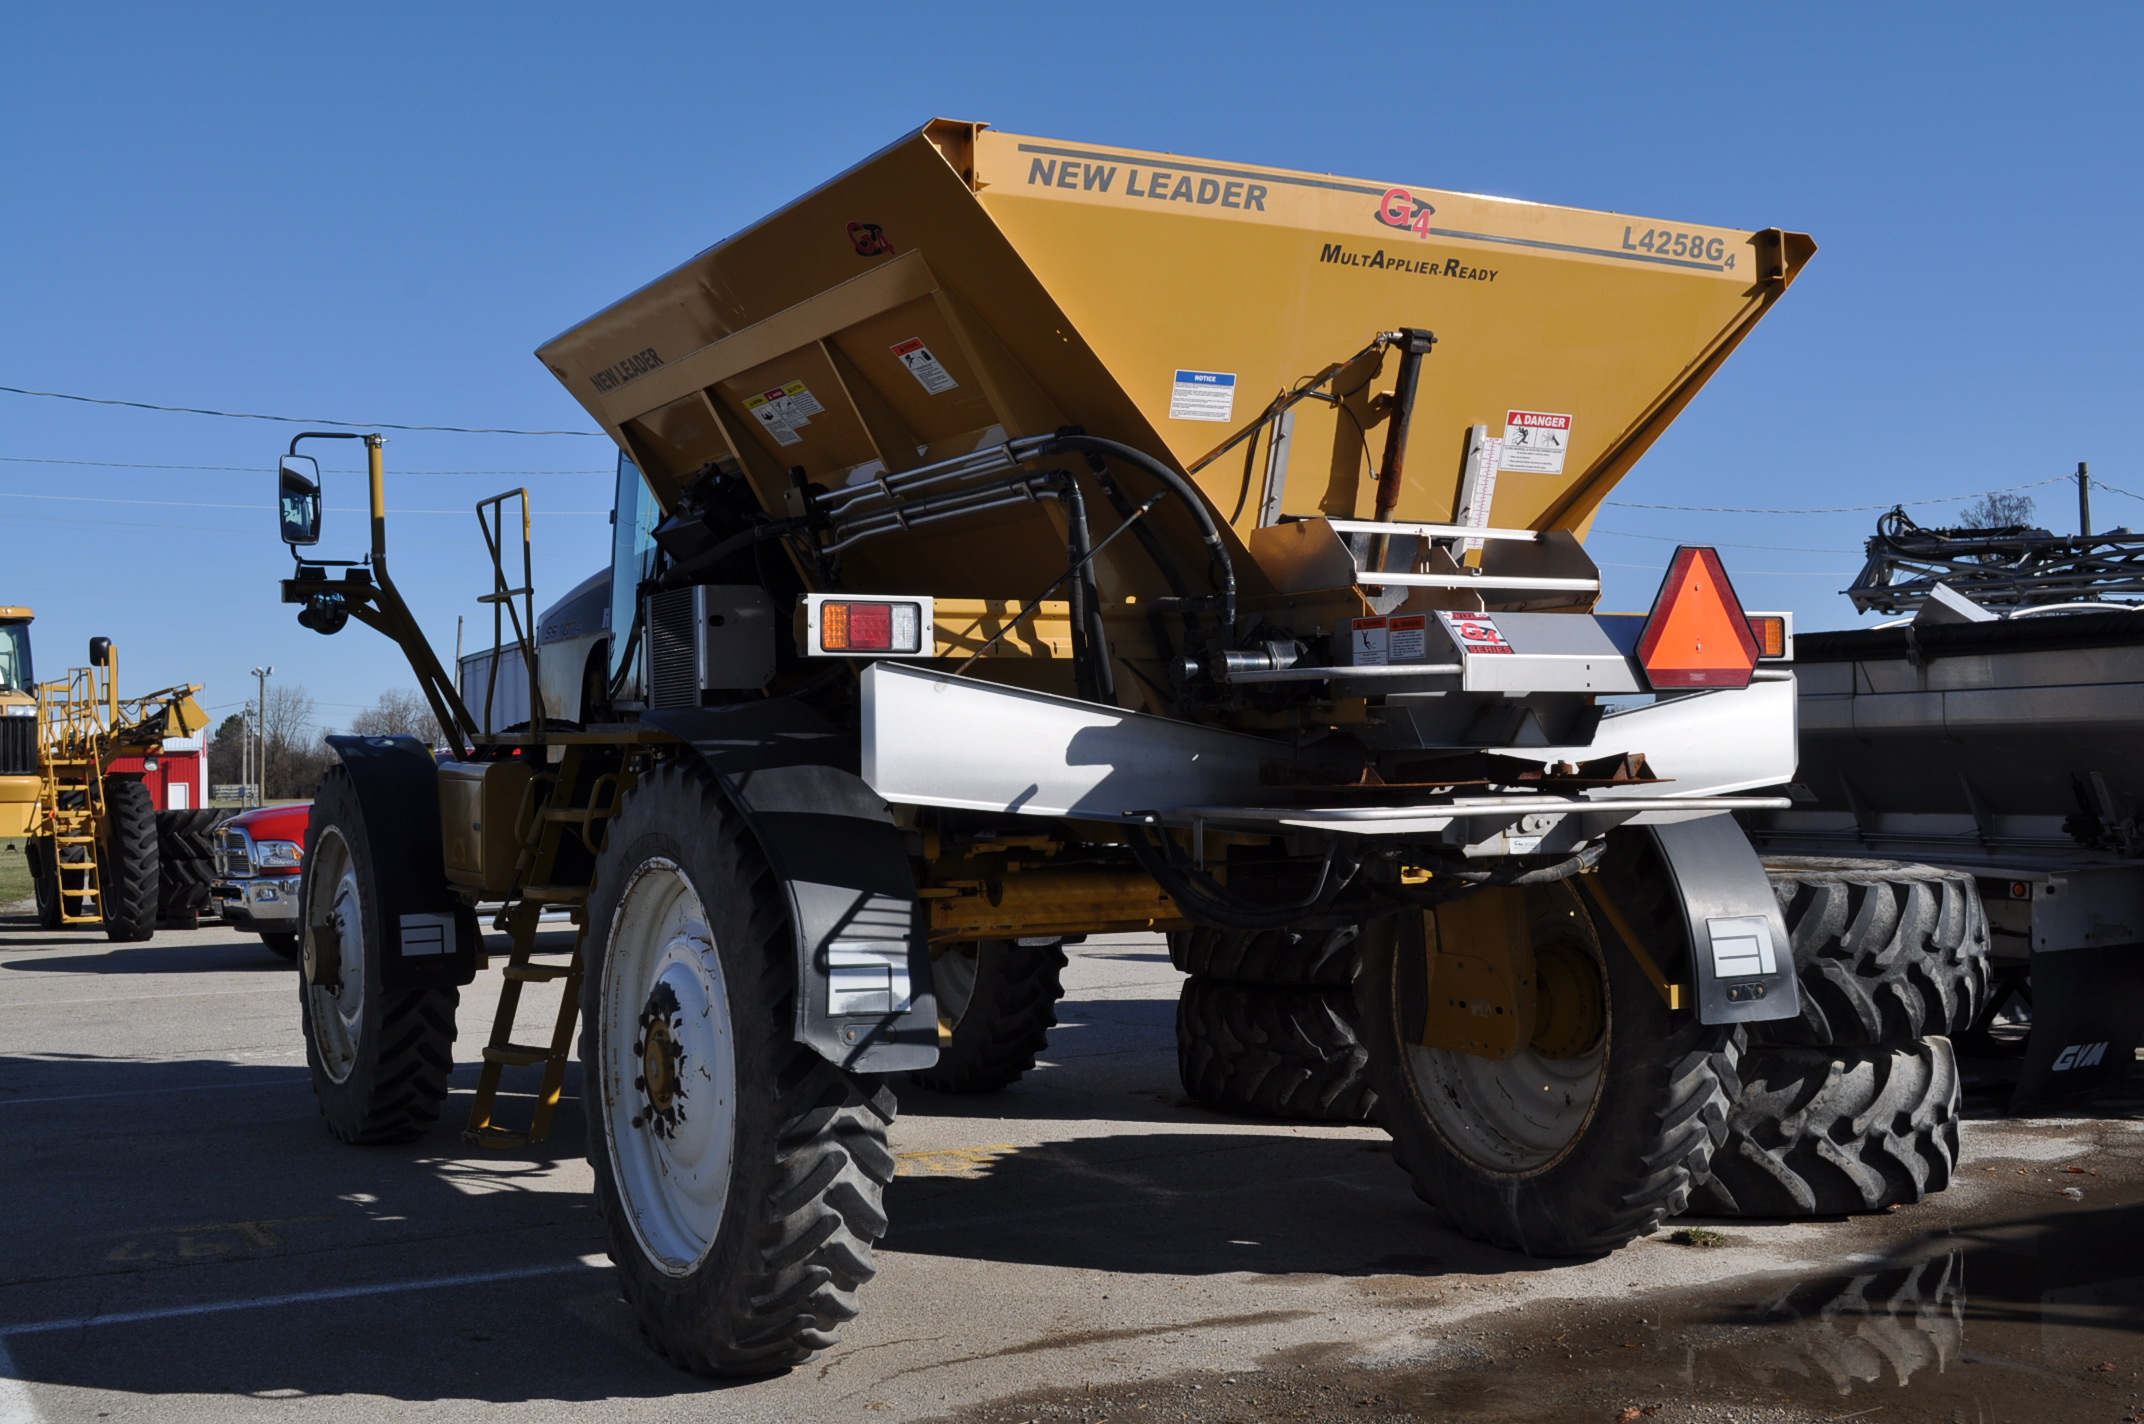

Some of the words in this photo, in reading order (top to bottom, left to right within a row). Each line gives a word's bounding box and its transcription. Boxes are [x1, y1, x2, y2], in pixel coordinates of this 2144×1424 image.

[1027, 157, 1117, 193] NEW
[1124, 169, 1268, 212] LEADER
[1379, 187, 1432, 240] G4
[1622, 226, 1736, 270] L4258G4
[589, 368, 620, 393] NEW
[613, 347, 665, 382] LEADER
[1194, 375, 1217, 383] NOTICE
[1523, 414, 1566, 428] DANGER
[1461, 622, 1500, 644] G4
[1468, 645, 1512, 654] SERIES
[2052, 1041, 2109, 1071] GVM
